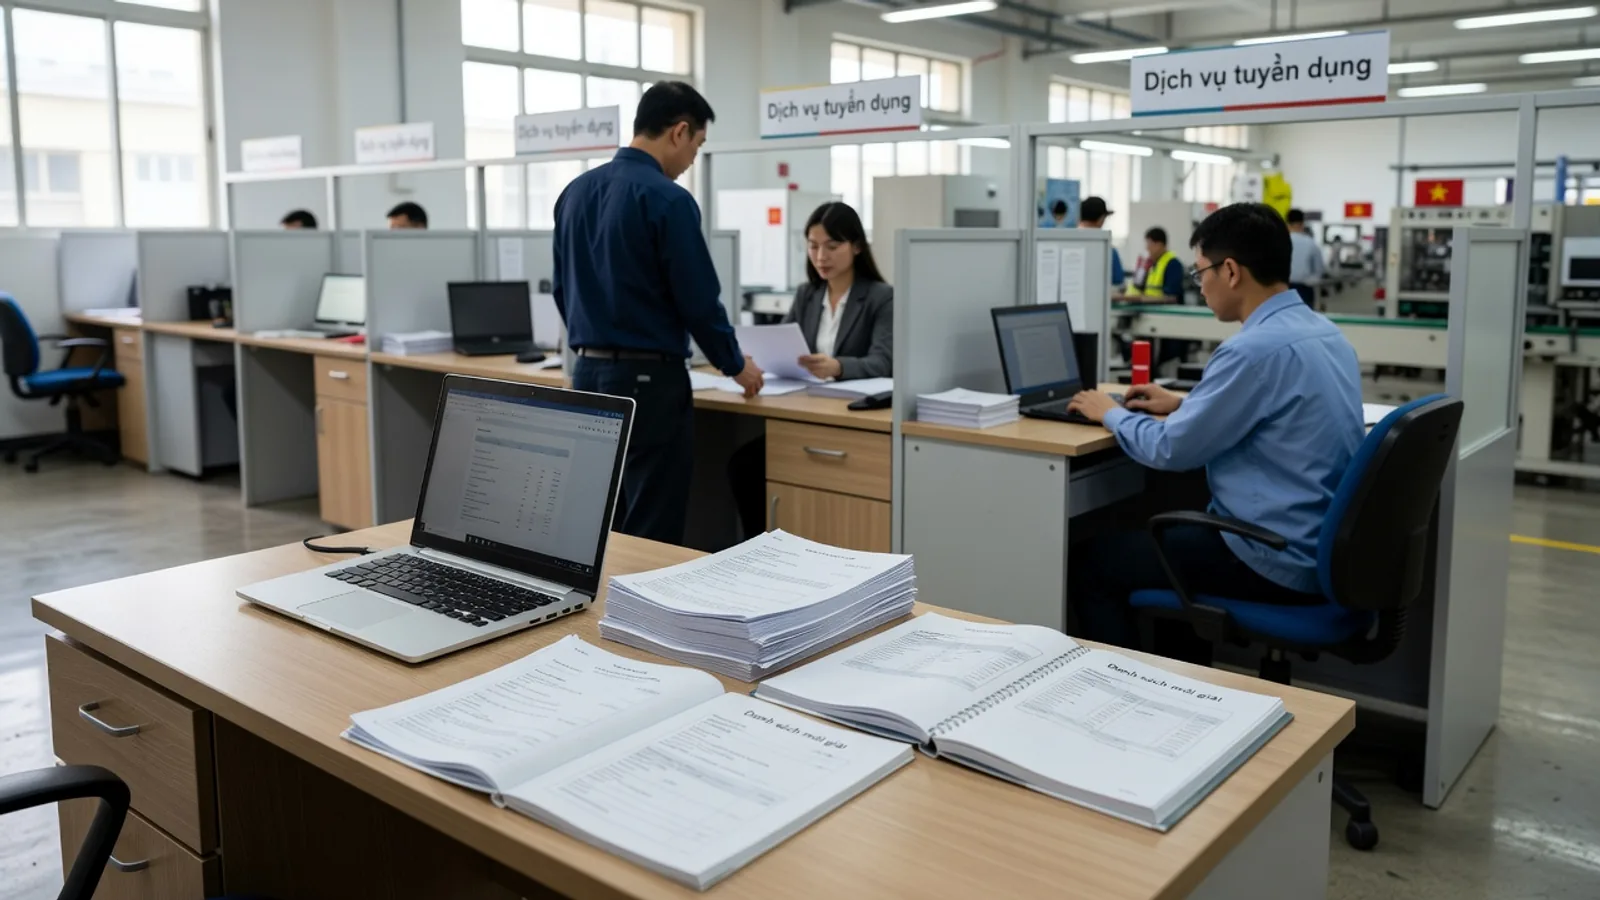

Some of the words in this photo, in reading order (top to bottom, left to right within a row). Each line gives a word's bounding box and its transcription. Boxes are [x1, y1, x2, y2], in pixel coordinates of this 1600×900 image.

[1144, 67, 1192, 95] Dịch
[1200, 69, 1226, 92] vụ
[1234, 53, 1299, 89] tuyển
[1308, 56, 1372, 83] dụng
[767, 101, 798, 122] Dịch
[802, 103, 820, 121] vụ
[870, 93, 911, 115] dụng
